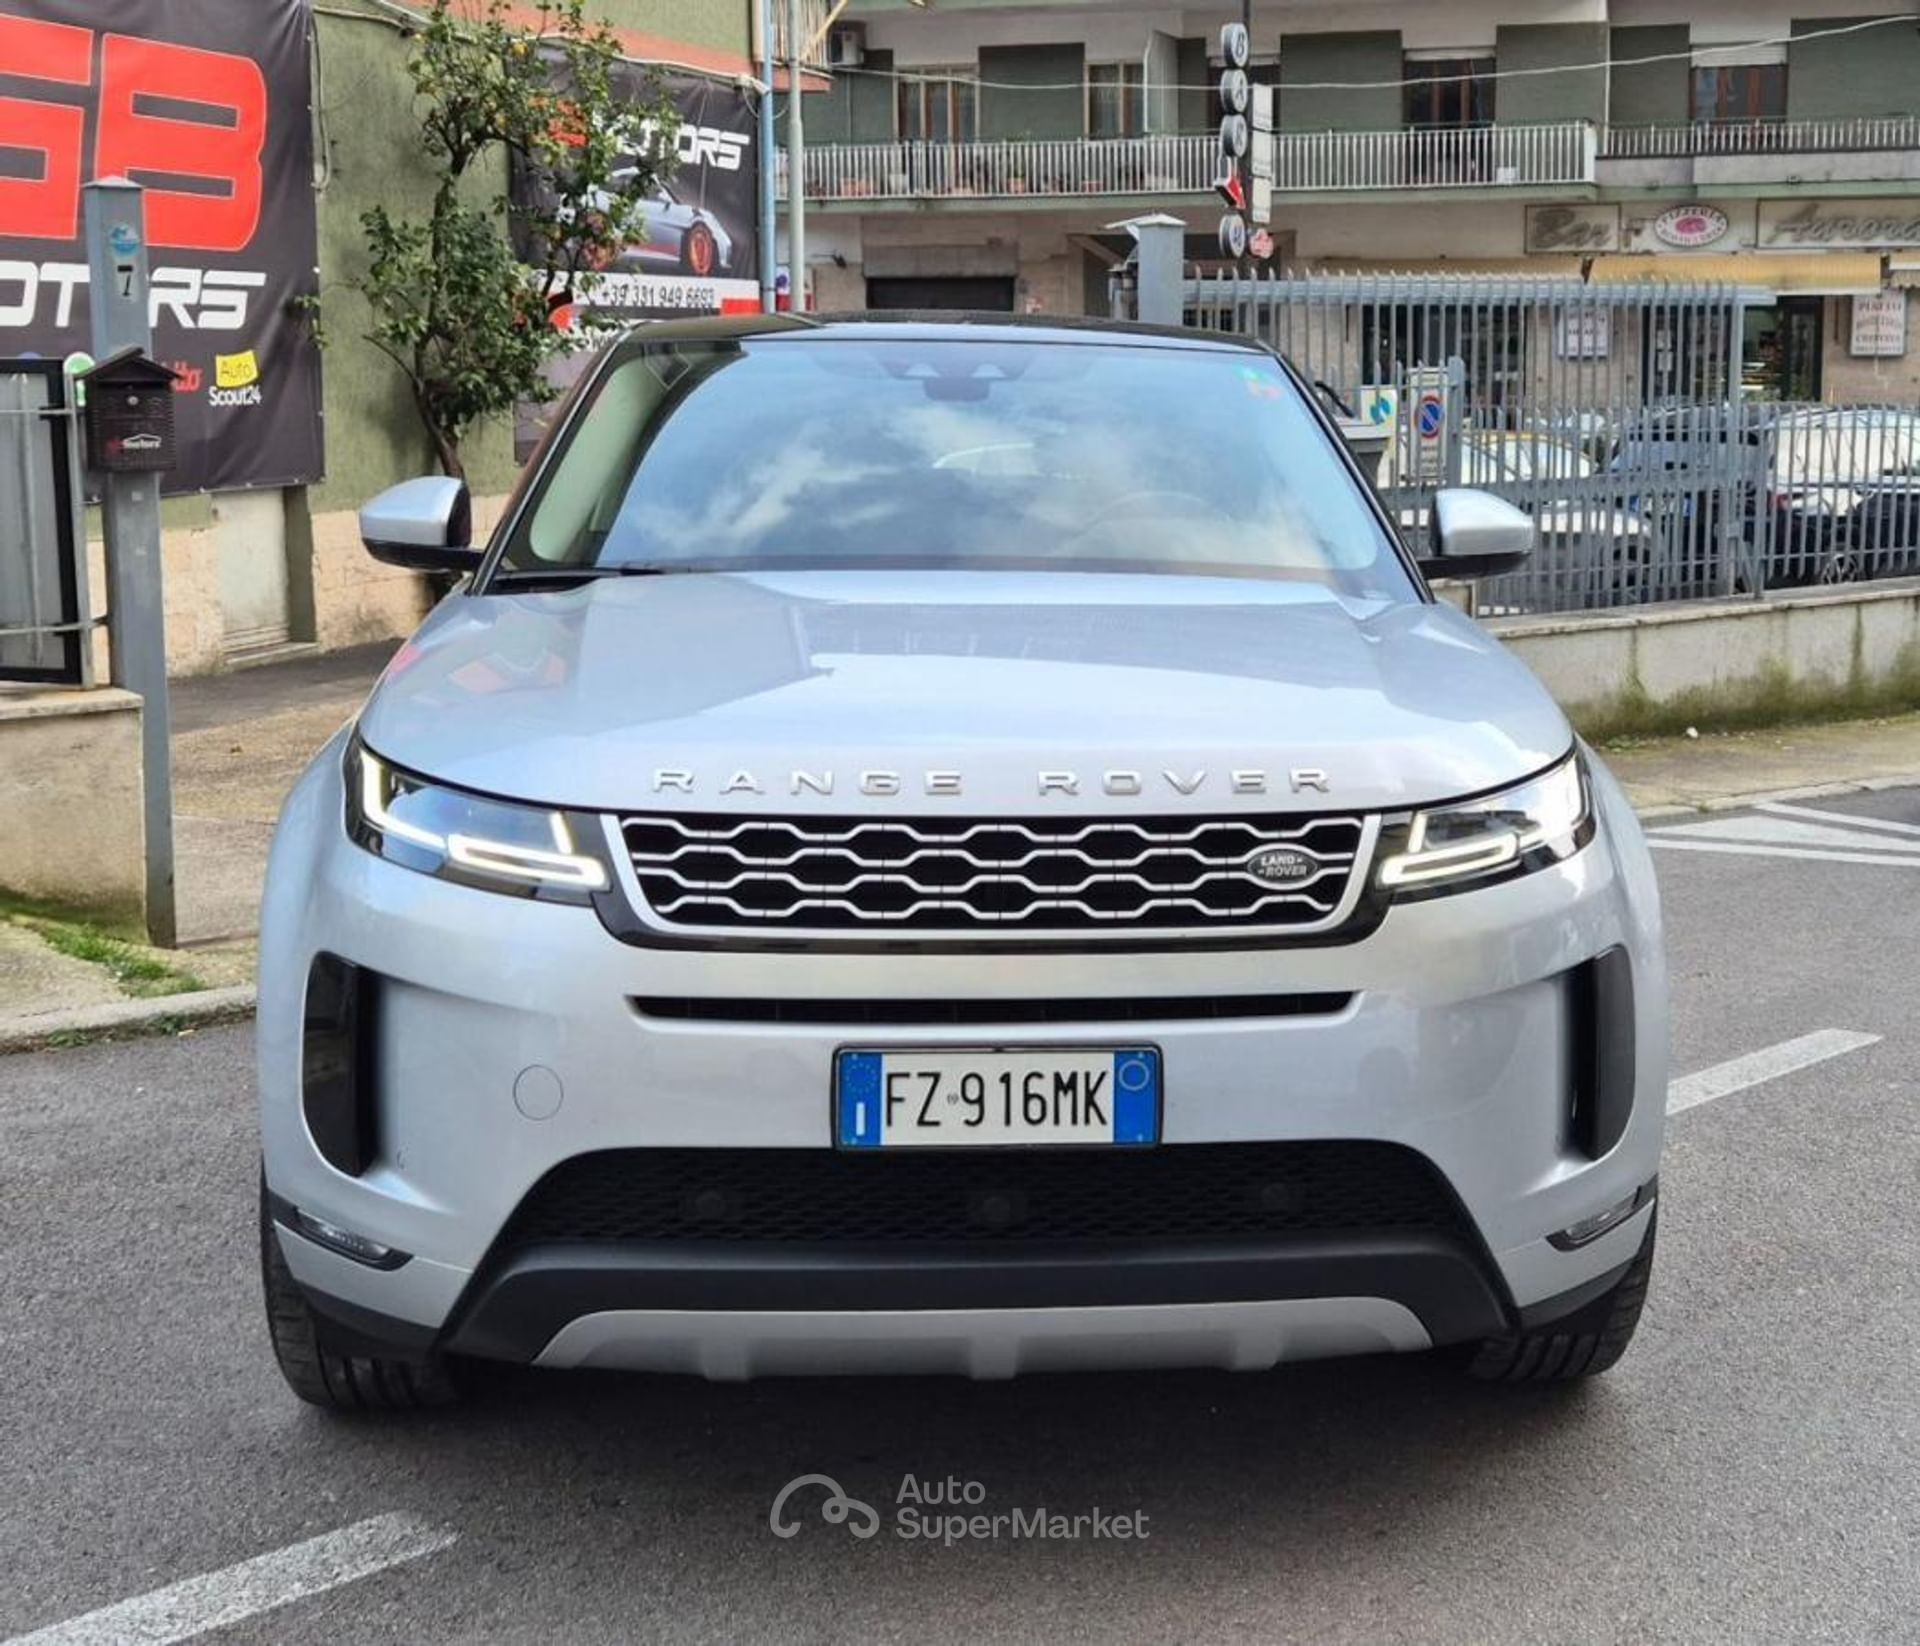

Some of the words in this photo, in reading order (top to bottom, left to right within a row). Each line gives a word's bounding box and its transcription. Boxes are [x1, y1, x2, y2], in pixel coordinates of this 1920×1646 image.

[117, 264, 133, 296] 7
[221, 361, 251, 380] Auto
[208, 386, 262, 406] Scout24
[652, 768, 965, 796] RANGE
[1036, 767, 1331, 797] ROVER
[1261, 855, 1296, 867] LAND
[1265, 865, 1308, 877] ROVER
